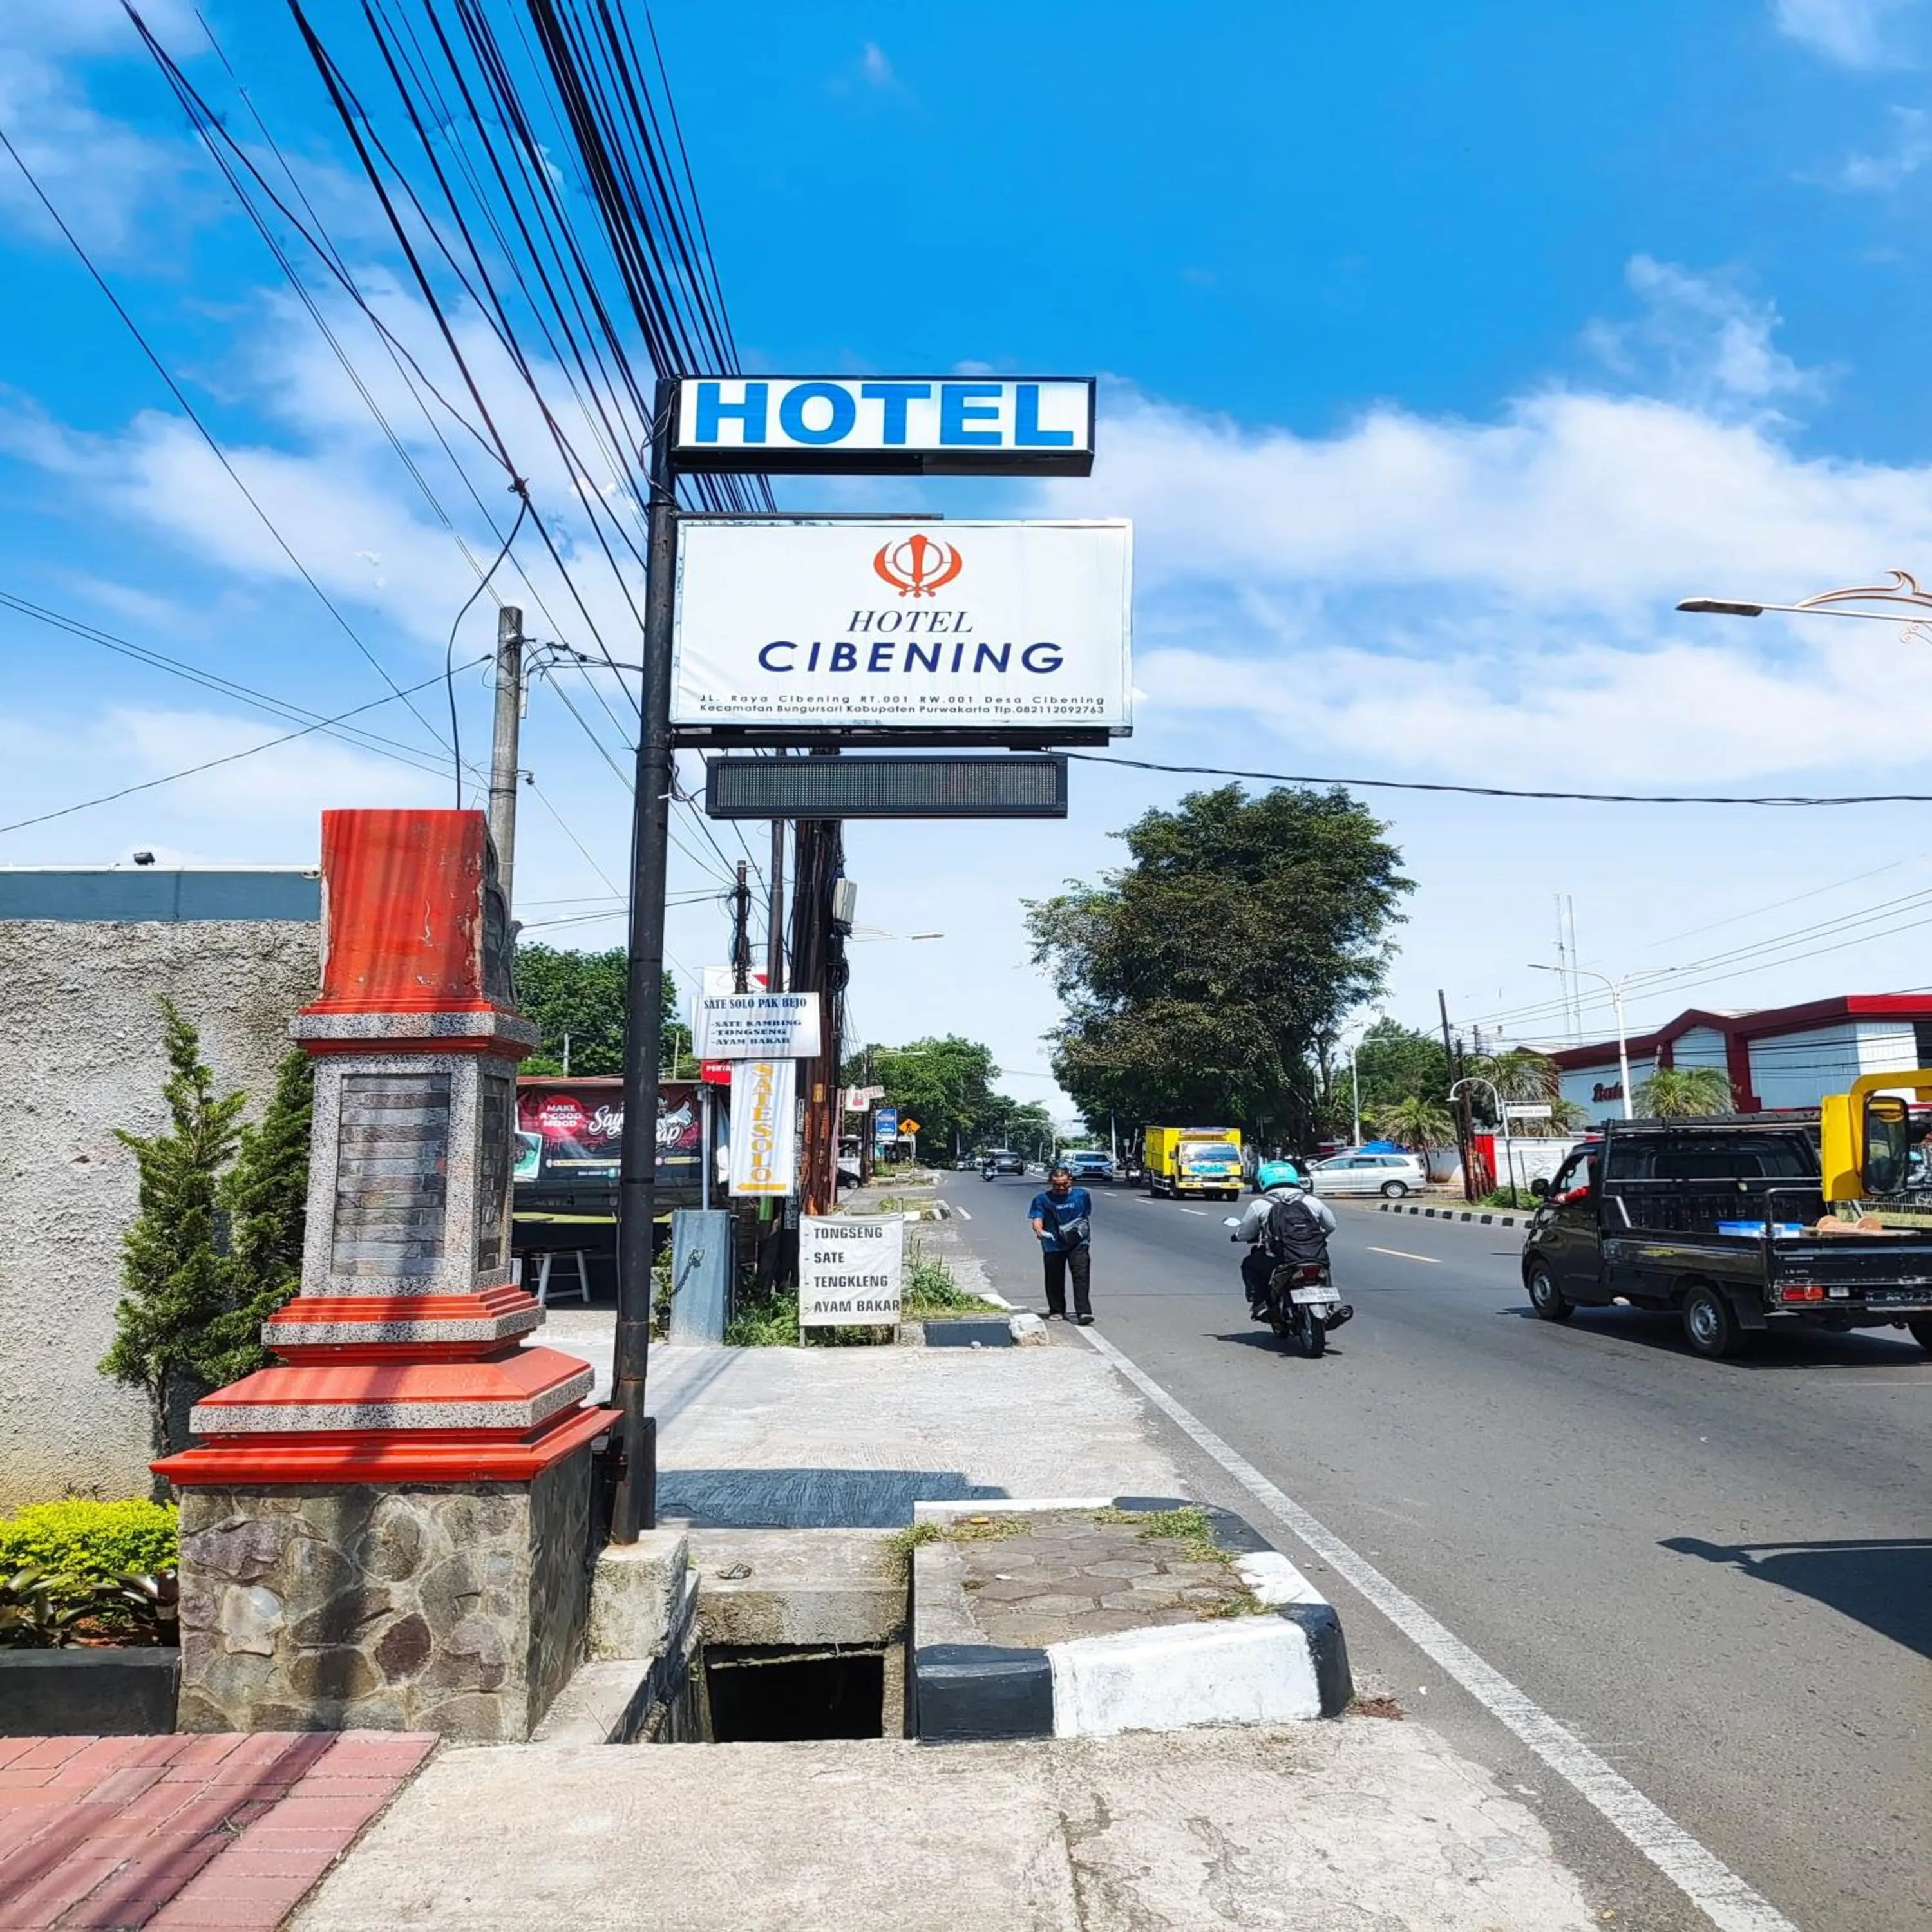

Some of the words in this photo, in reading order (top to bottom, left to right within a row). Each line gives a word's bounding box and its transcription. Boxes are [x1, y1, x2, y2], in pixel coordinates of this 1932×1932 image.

[696, 382, 1074, 446] HOTEL
[846, 610, 974, 633] HOTEL
[758, 641, 1064, 674] CIBENING
[731, 694, 768, 704] Raya
[779, 694, 850, 705] Cibening
[920, 696, 973, 704] RW.001
[985, 696, 1022, 705] Desa
[1032, 696, 1104, 705] Cibening
[700, 704, 772, 712] Kecamatan
[777, 705, 842, 714] Bungursari
[846, 705, 915, 714] Kabupaten
[920, 705, 990, 714] Purwakarta
[704, 999, 726, 1009] SATE
[729, 999, 754, 1009] SOLO
[758, 998, 779, 1008] PAK
[782, 998, 806, 1009] BEJO
[814, 1227, 883, 1239] TONGSENG
[814, 1251, 845, 1264] SATE
[814, 1275, 888, 1288] TENGKLENG
[814, 1300, 852, 1312] AYAM
[857, 1300, 900, 1312] BAKAR
